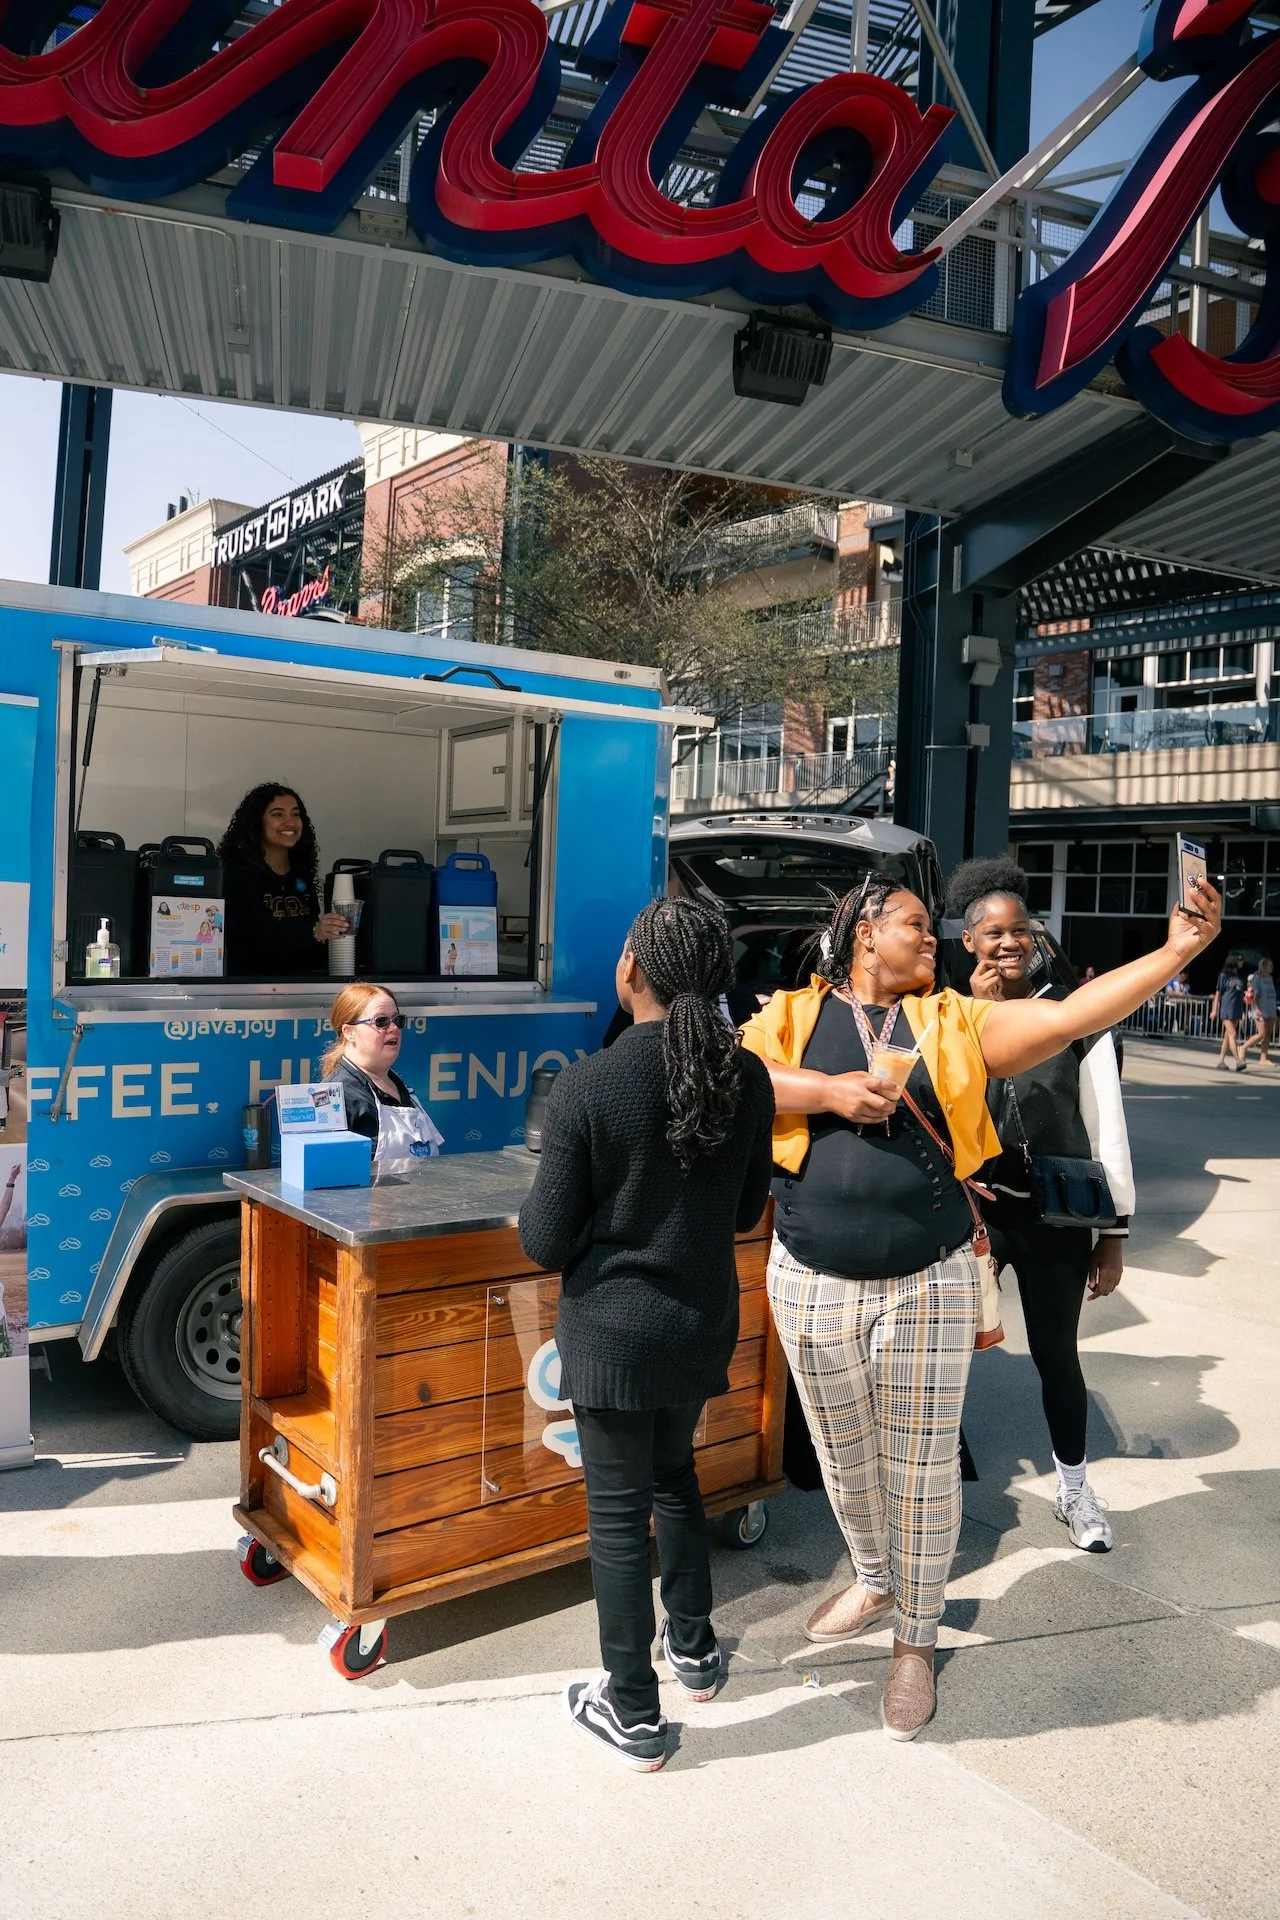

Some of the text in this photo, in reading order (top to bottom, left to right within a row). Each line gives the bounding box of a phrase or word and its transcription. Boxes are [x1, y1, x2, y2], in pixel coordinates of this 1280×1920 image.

[210, 479, 344, 568] TRUIST PARK
[261, 564, 331, 616] Braves
